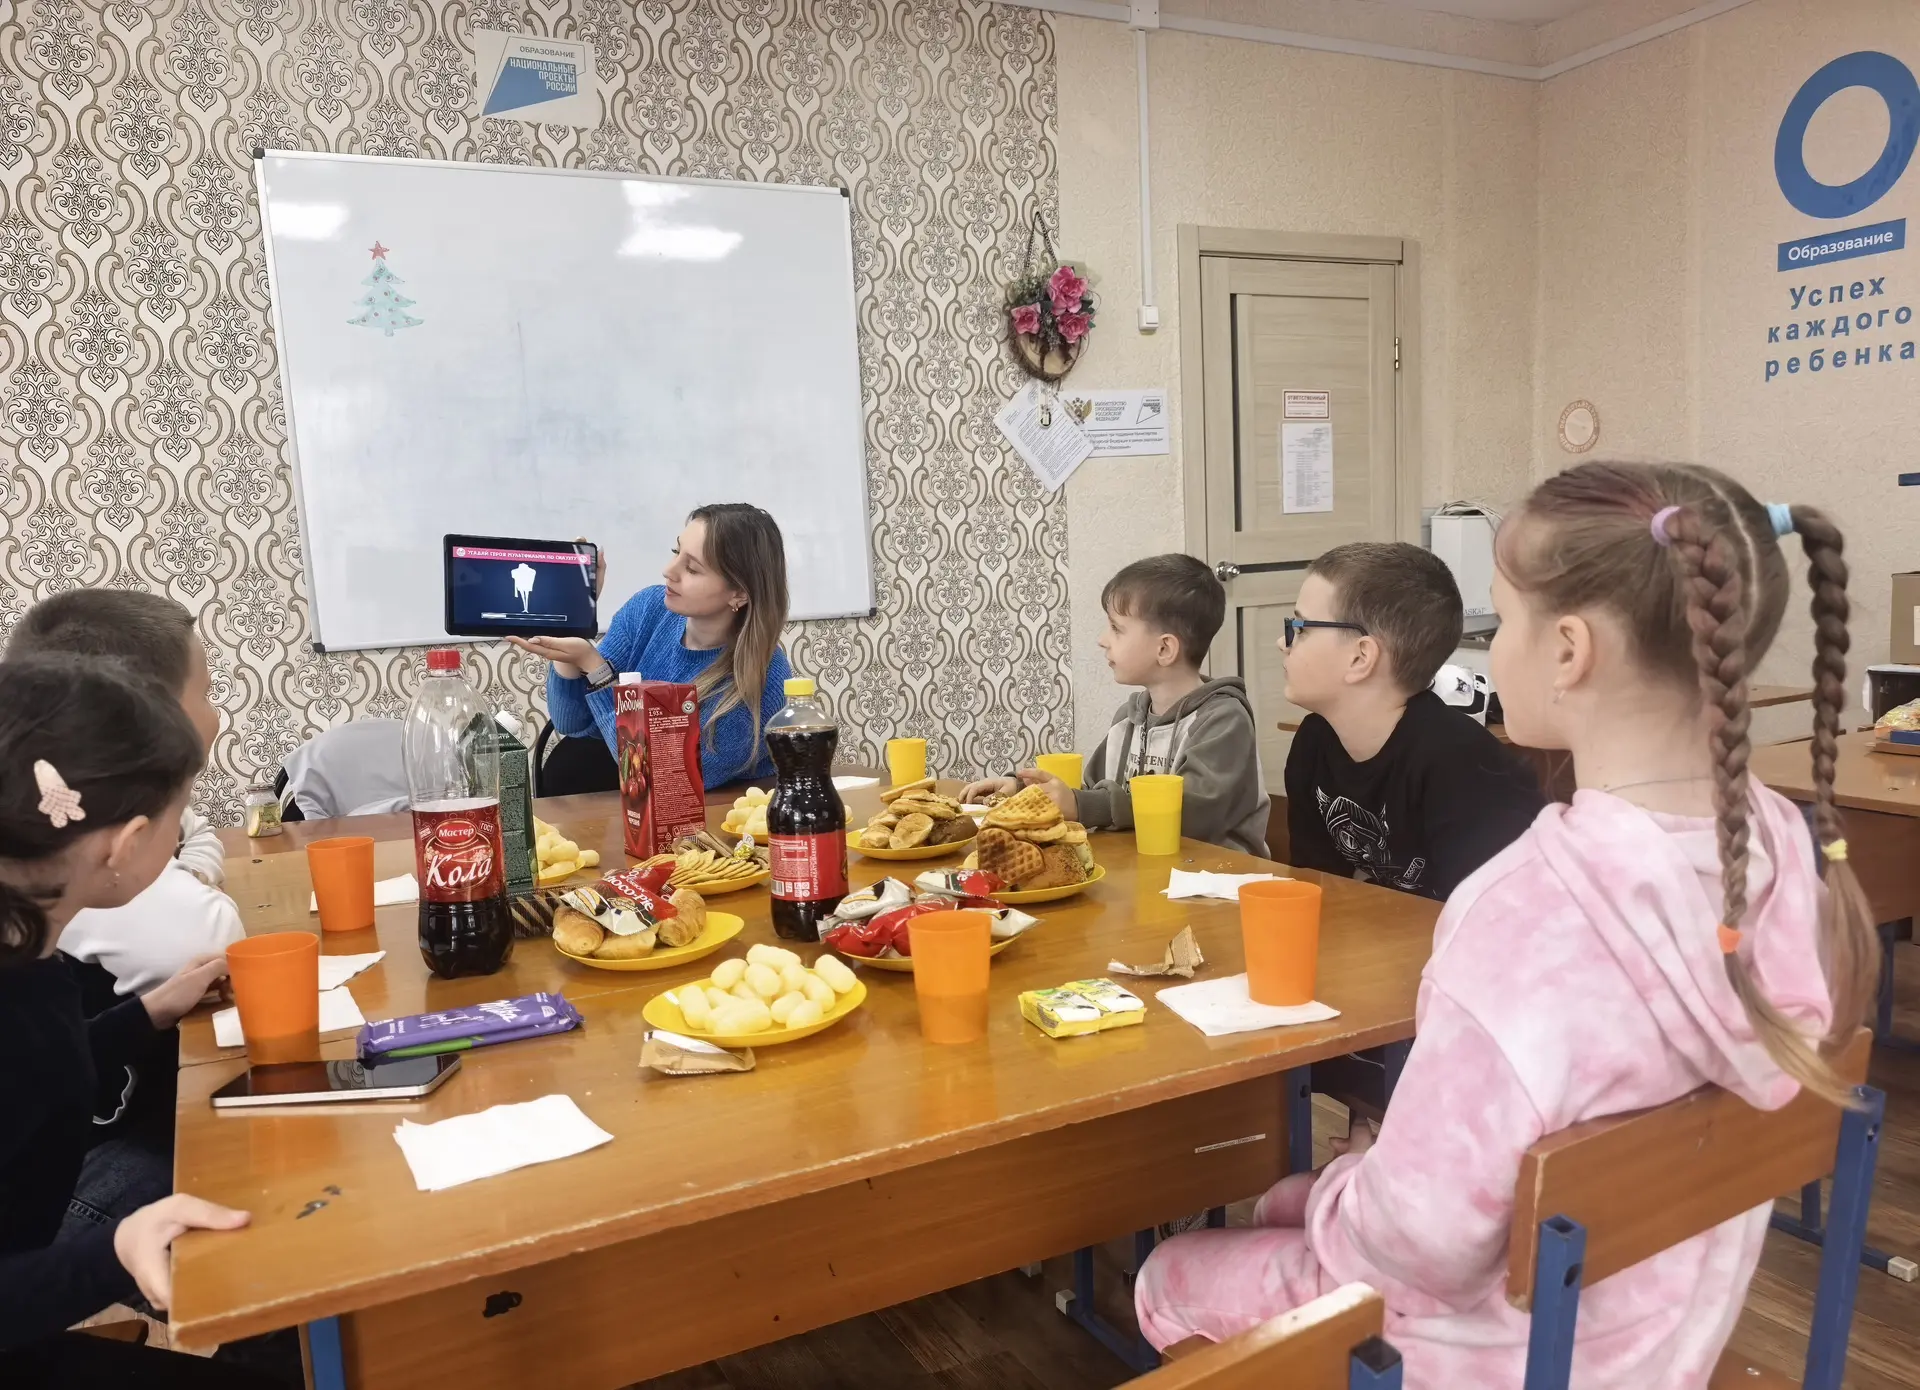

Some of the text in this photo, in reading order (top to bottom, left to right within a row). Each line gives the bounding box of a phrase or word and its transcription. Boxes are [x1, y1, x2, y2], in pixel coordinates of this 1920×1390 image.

[519, 45, 576, 59] ОБРАЗОВАНИЕ
[510, 58, 576, 75] НАЦИОНАЛЬНЫЕ
[538, 70, 576, 84] ПРОЕКТЫ
[545, 80, 577, 93] РОССИИ
[1787, 230, 1894, 261] Образование
[1789, 276, 1886, 311] Успех
[1767, 305, 1913, 344] каждого
[1764, 340, 1916, 383] ребенка
[438, 827, 475, 838] Мастер
[480, 821, 494, 833] ГОСТ
[426, 853, 492, 887] Кола
[606, 874, 655, 912] hoco-Pie
